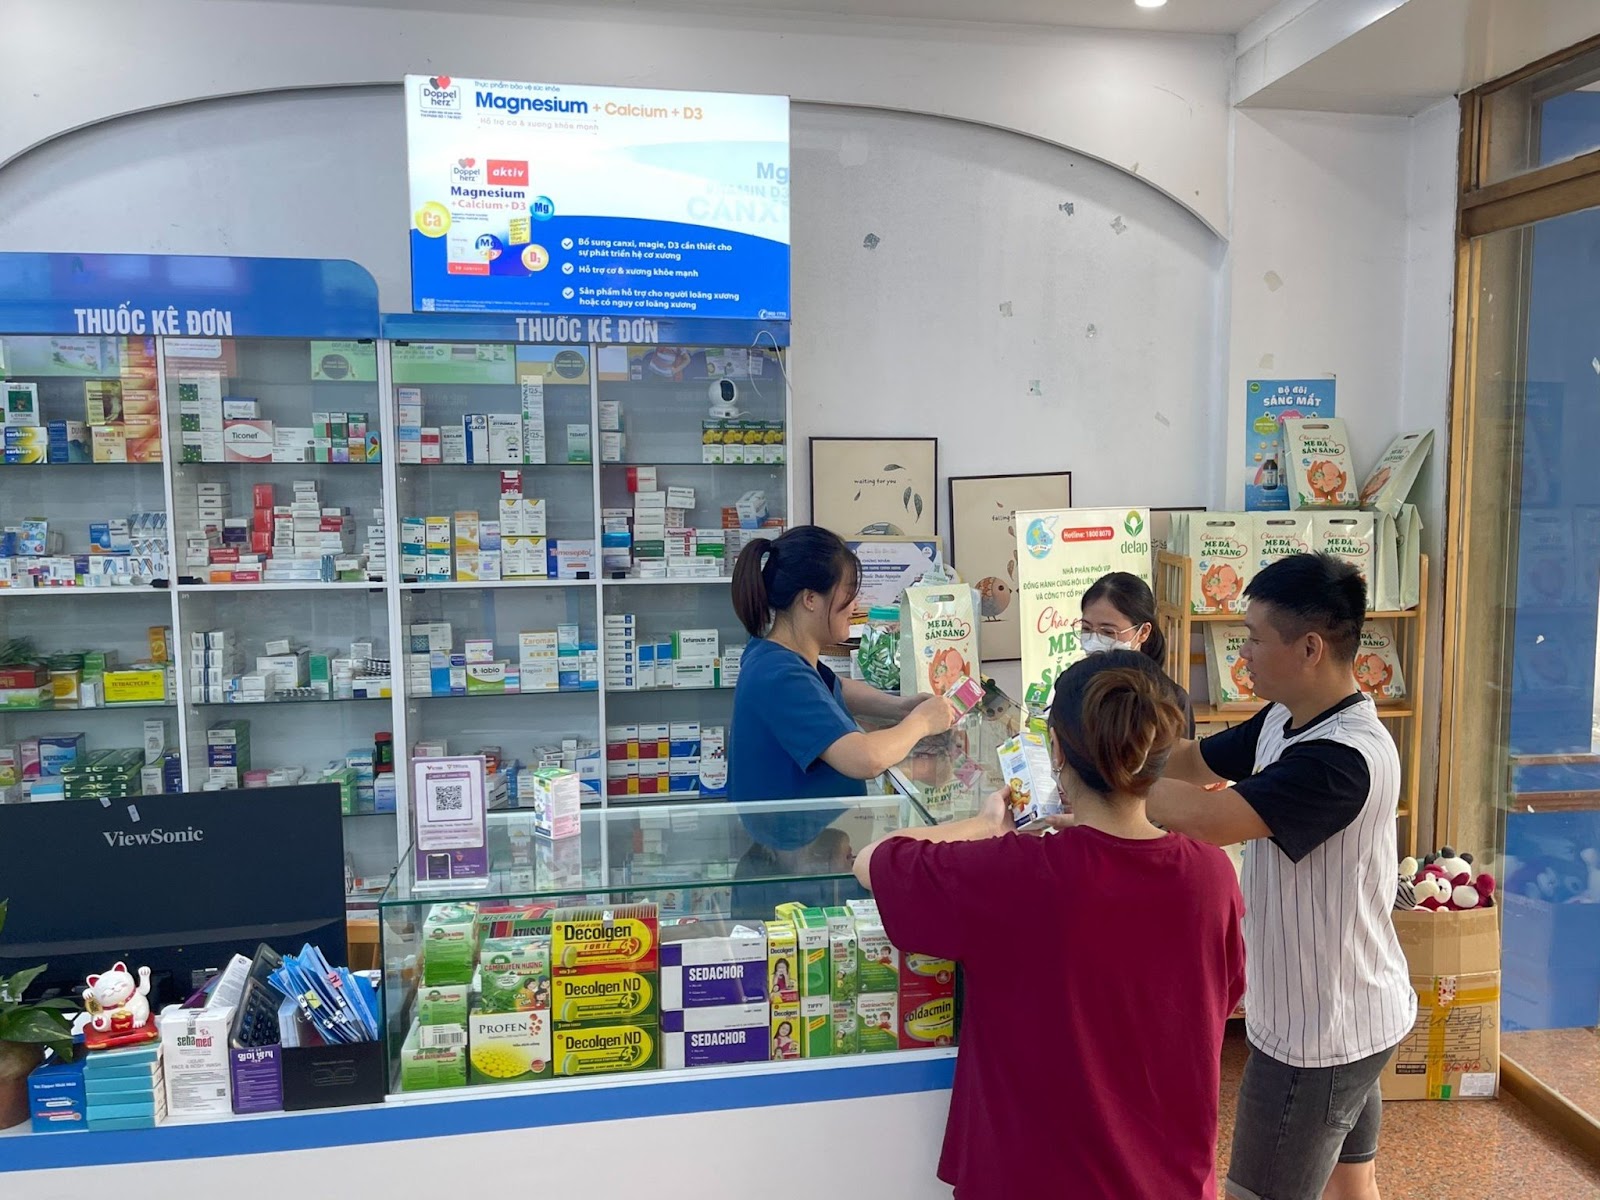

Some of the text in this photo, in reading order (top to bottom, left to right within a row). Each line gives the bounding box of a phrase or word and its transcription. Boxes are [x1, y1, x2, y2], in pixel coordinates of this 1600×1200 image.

[424, 88, 457, 101] Doppel
[431, 95, 451, 106] herz
[475, 91, 589, 115] Magnesium
[604, 102, 668, 118] Calcium
[683, 107, 703, 120] D3
[492, 167, 524, 178] aktiv
[757, 162, 789, 185] Mg
[450, 186, 525, 199] Magnesium
[458, 200, 503, 209] Calcium
[511, 201, 526, 210] D3
[534, 202, 549, 214] Mg
[422, 211, 442, 227] Ca
[591, 240, 611, 248] sung
[613, 240, 636, 248] canxi,
[639, 241, 666, 249] magie,
[668, 241, 679, 249] D3
[681, 242, 695, 250] cần
[697, 242, 716, 250] thiết
[717, 243, 732, 251] cho
[590, 249, 609, 258] phát
[611, 249, 630, 258] triển
[632, 250, 642, 260] hệ
[655, 252, 681, 261] xương
[578, 265, 590, 273] Hỗ
[592, 266, 605, 275] trợ
[626, 268, 652, 277] xương
[653, 267, 674, 276] khỏe
[675, 269, 699, 279] mạnh
[579, 287, 594, 295] Sản
[596, 287, 620, 297] phẩm
[622, 288, 632, 296] hỗ
[634, 289, 646, 297] trợ
[648, 289, 663, 297] cho
[664, 289, 688, 299] người
[714, 292, 739, 301] xương
[579, 298, 599, 306] hoặc
[601, 298, 611, 306] có
[612, 300, 633, 308] nguy
[634, 299, 645, 307] cơ
[671, 301, 697, 310] xương
[74, 301, 233, 336] THUỐC KÊ ĐƠN
[515, 315, 659, 344] THUỐC KÊ ĐƠN
[522, 379, 530, 410] ZINNAT
[1278, 386, 1307, 395] Bộ đôi
[1263, 393, 1321, 407] SÁNG MẮT
[231, 431, 258, 440] Ticonet
[854, 478, 875, 486] waiting
[1063, 530, 1085, 539] Hotline:
[1120, 541, 1148, 555] delap
[523, 638, 555, 646] Zaromax
[103, 826, 204, 847] ViewSonic
[564, 924, 632, 942] Decolgen
[770, 947, 794, 955] Decolgen
[689, 965, 744, 982] SEDACHOR
[564, 978, 641, 996] Decolgen ND
[479, 1022, 527, 1034] PROFEN
[177, 1036, 212, 1047] sebamed
[565, 1031, 642, 1049] Decolgen ND
[691, 1031, 746, 1047] SEDACHOR
